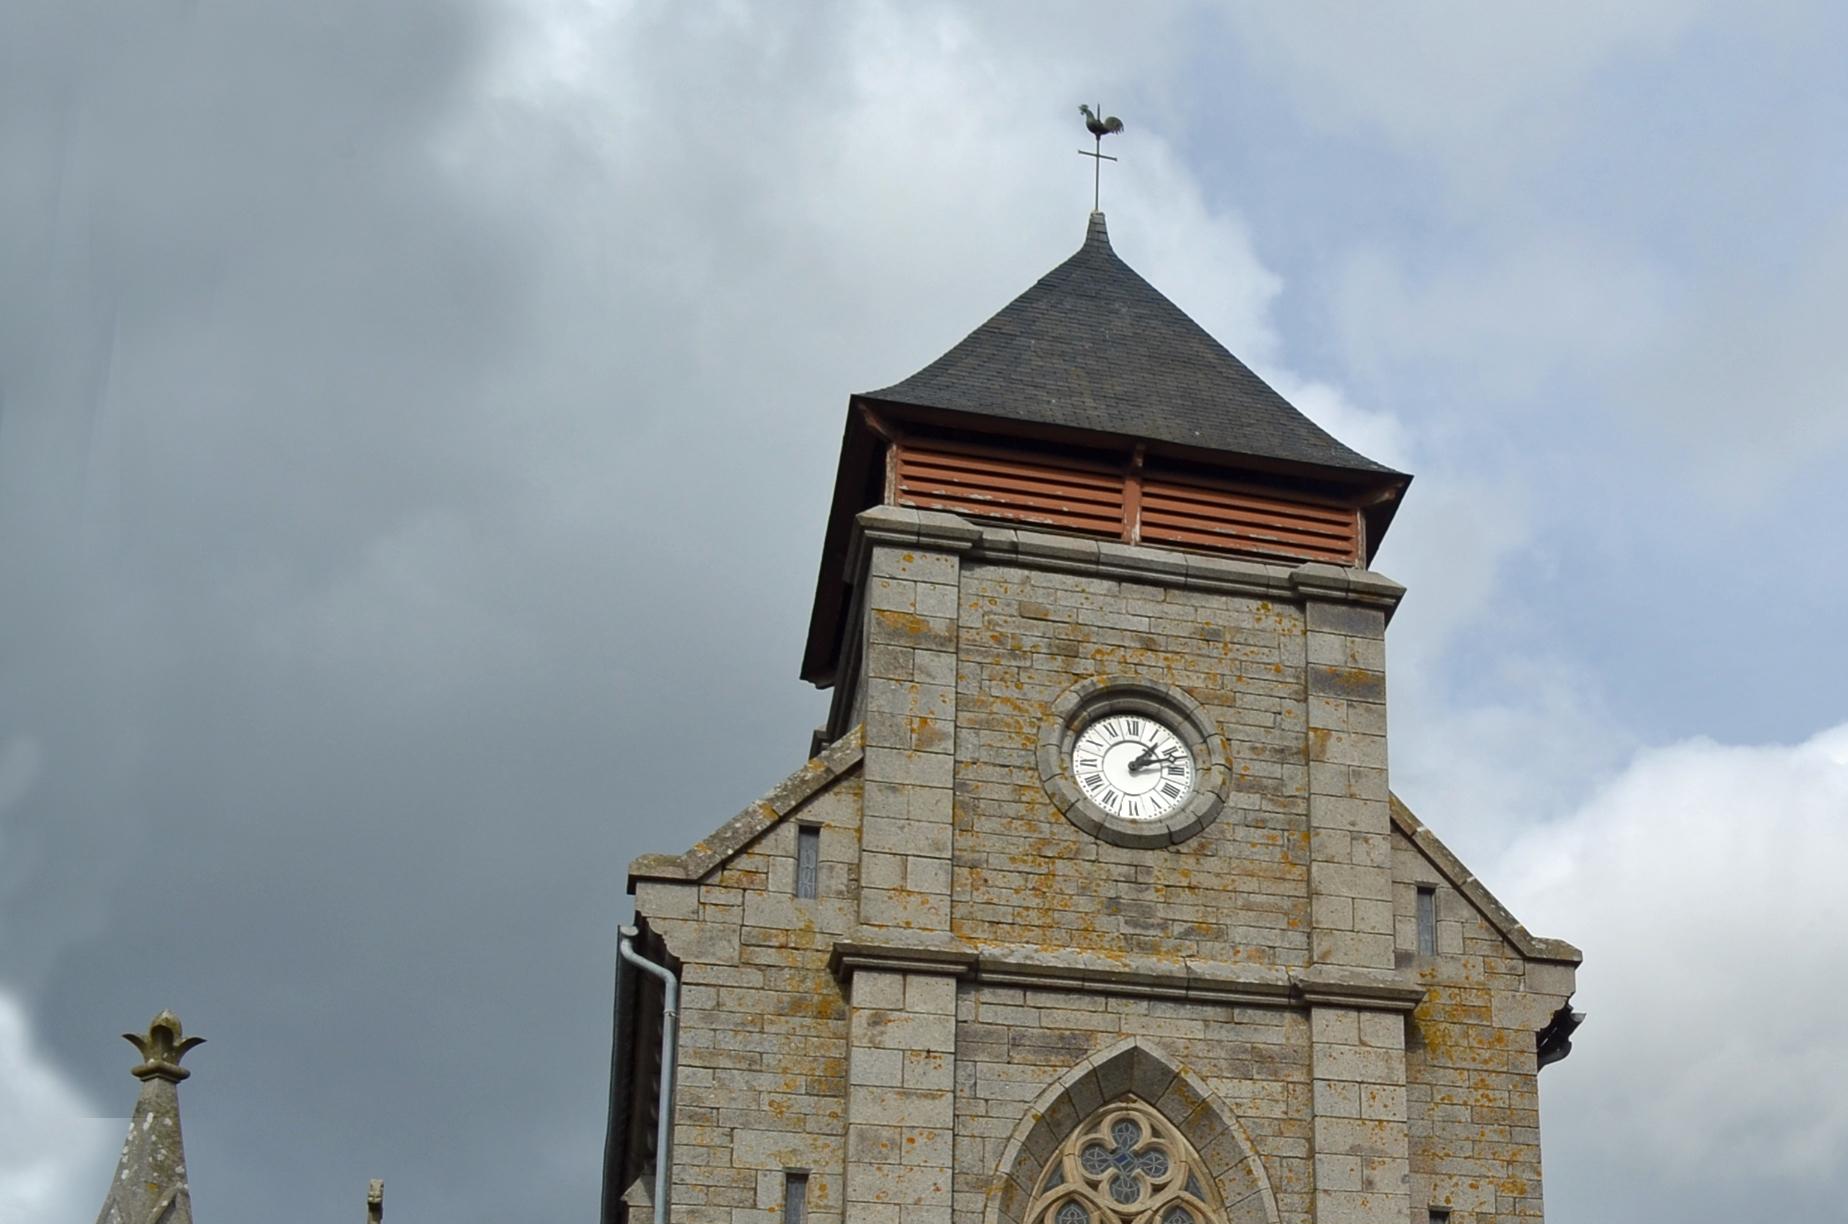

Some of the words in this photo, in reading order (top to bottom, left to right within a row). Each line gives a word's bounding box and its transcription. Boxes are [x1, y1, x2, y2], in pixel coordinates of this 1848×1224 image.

[1126, 720, 1139, 736] XII
[1149, 729, 1158, 741] I
[1167, 766, 1185, 776] III
